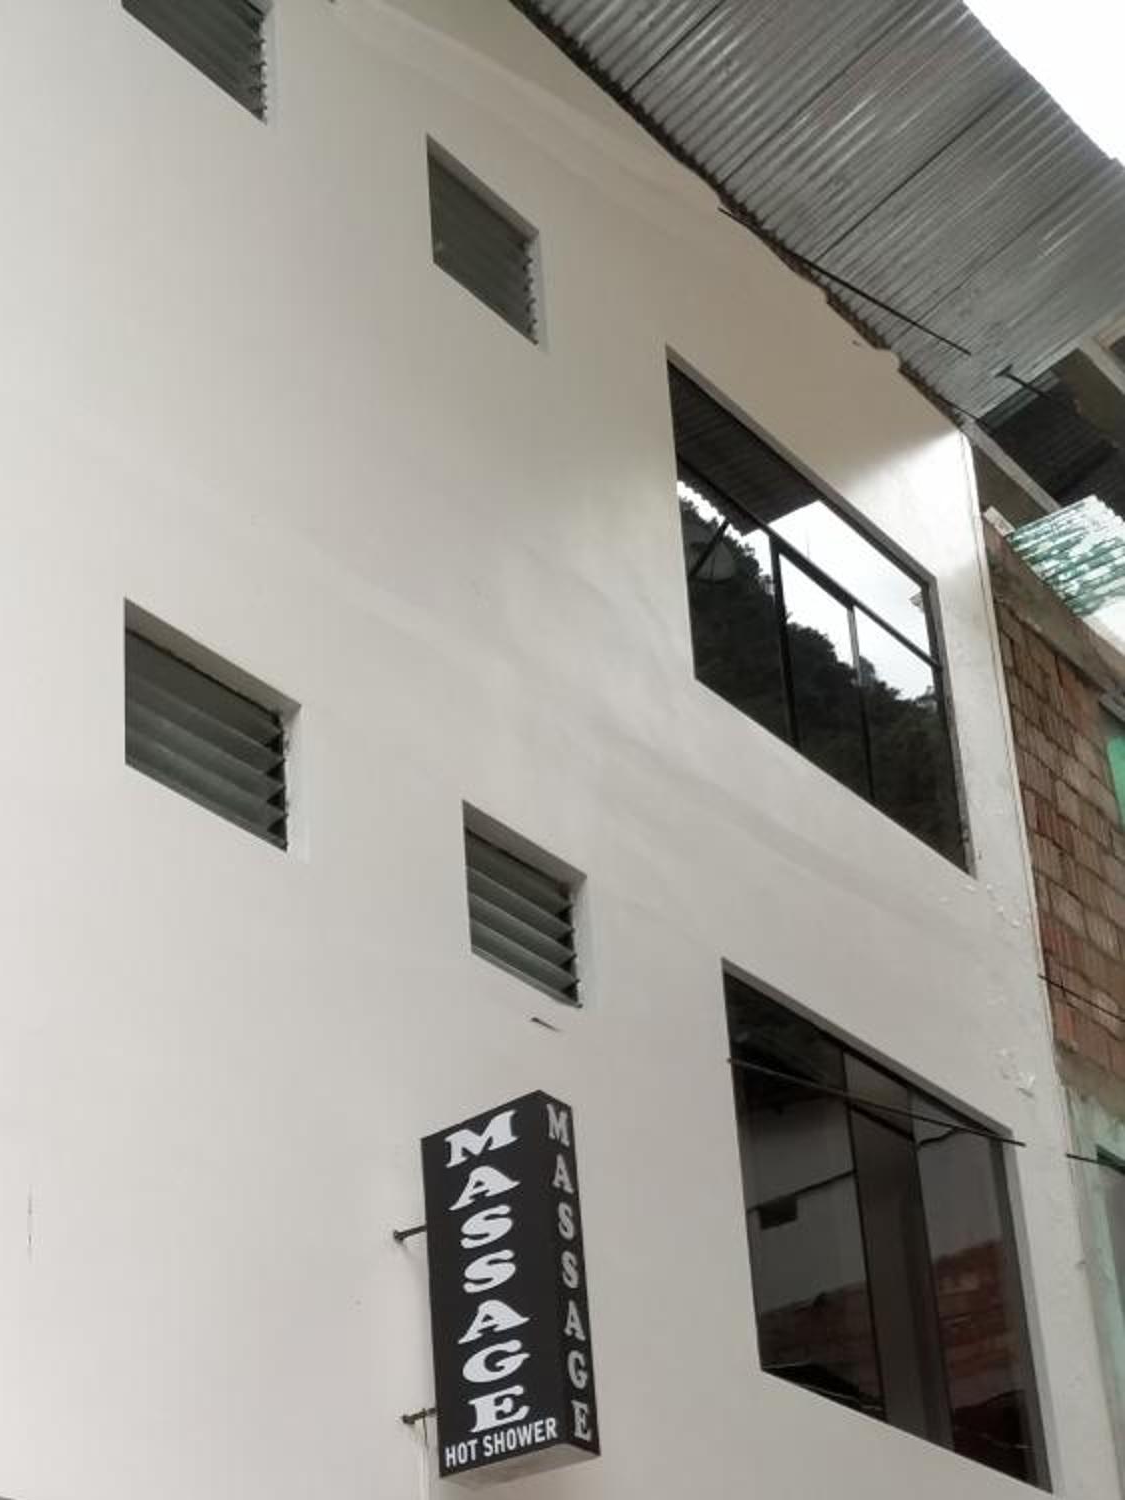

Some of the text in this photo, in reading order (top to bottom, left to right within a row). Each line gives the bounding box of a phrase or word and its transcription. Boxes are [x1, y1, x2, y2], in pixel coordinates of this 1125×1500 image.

[445, 1109, 530, 1433] MASSAGE
[546, 1103, 592, 1442] MASSAGE
[445, 1417, 558, 1468] HOT SHOWER
